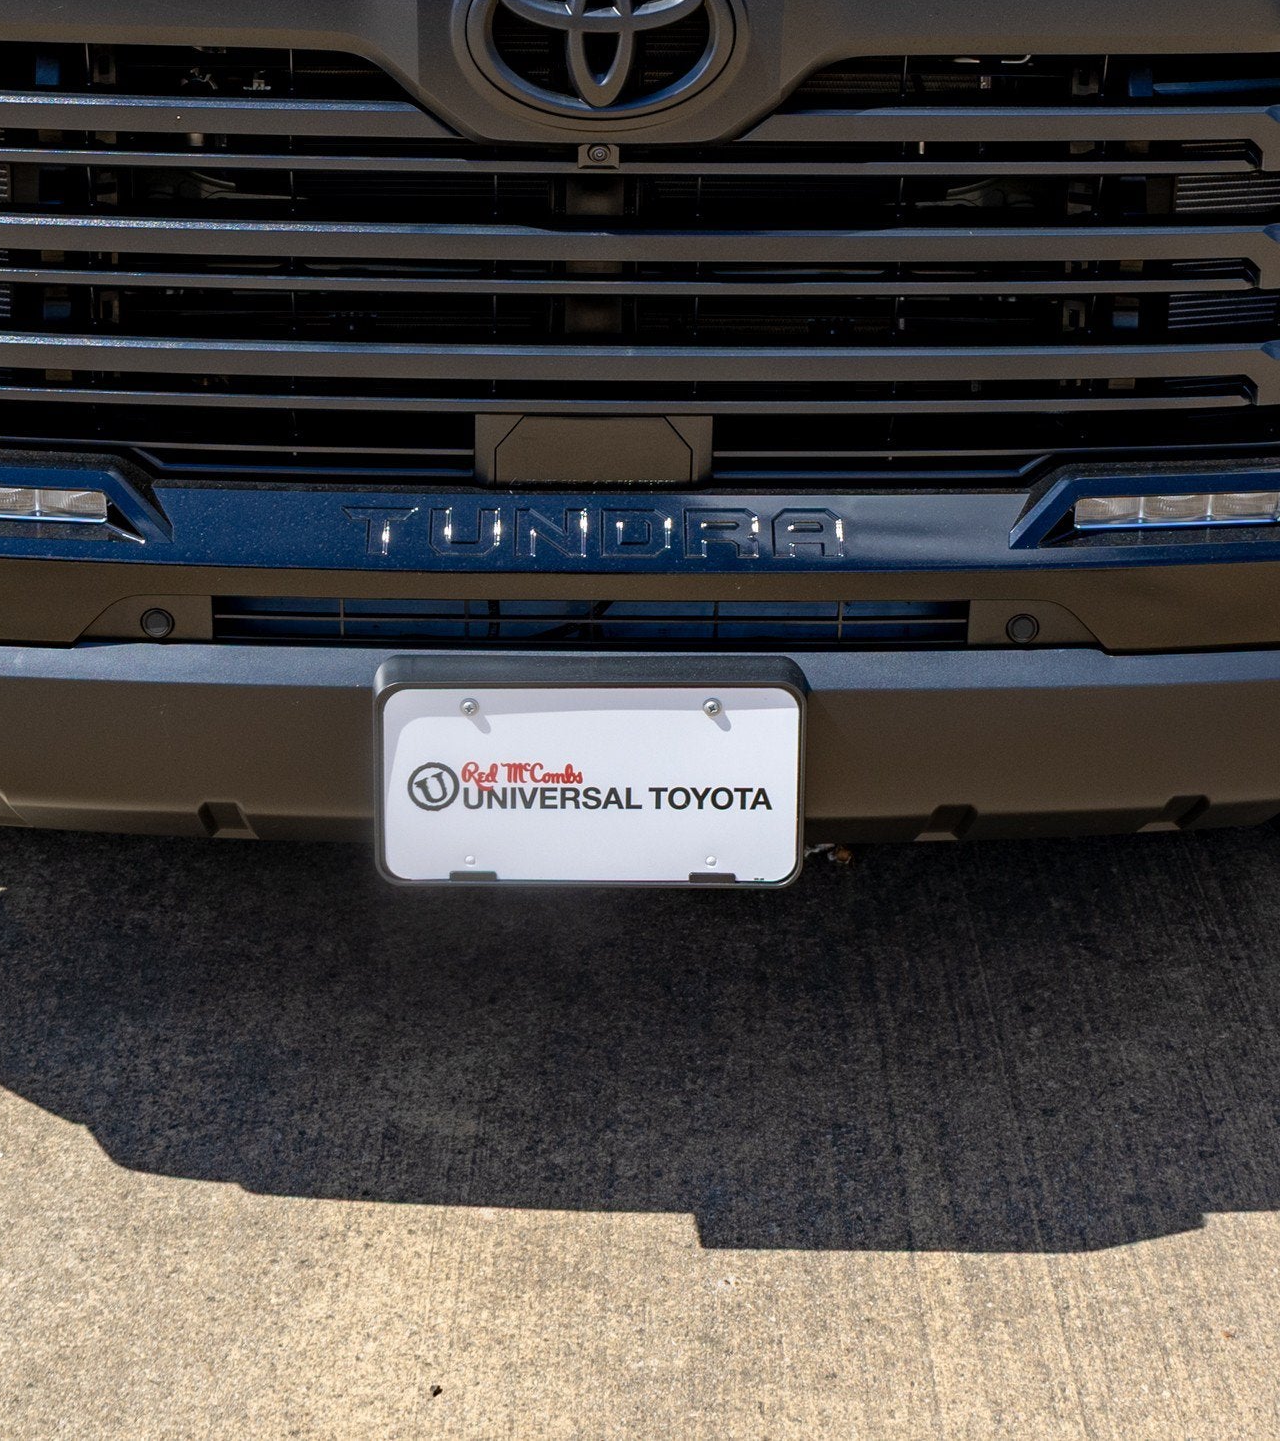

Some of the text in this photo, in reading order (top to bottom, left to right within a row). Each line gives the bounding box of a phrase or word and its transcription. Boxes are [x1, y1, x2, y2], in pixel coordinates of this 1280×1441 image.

[340, 506, 844, 558] TUNDRA
[461, 761, 584, 792] Red McCombs
[463, 786, 643, 811] UNIVERSAL
[648, 786, 773, 811] TOYOTA
